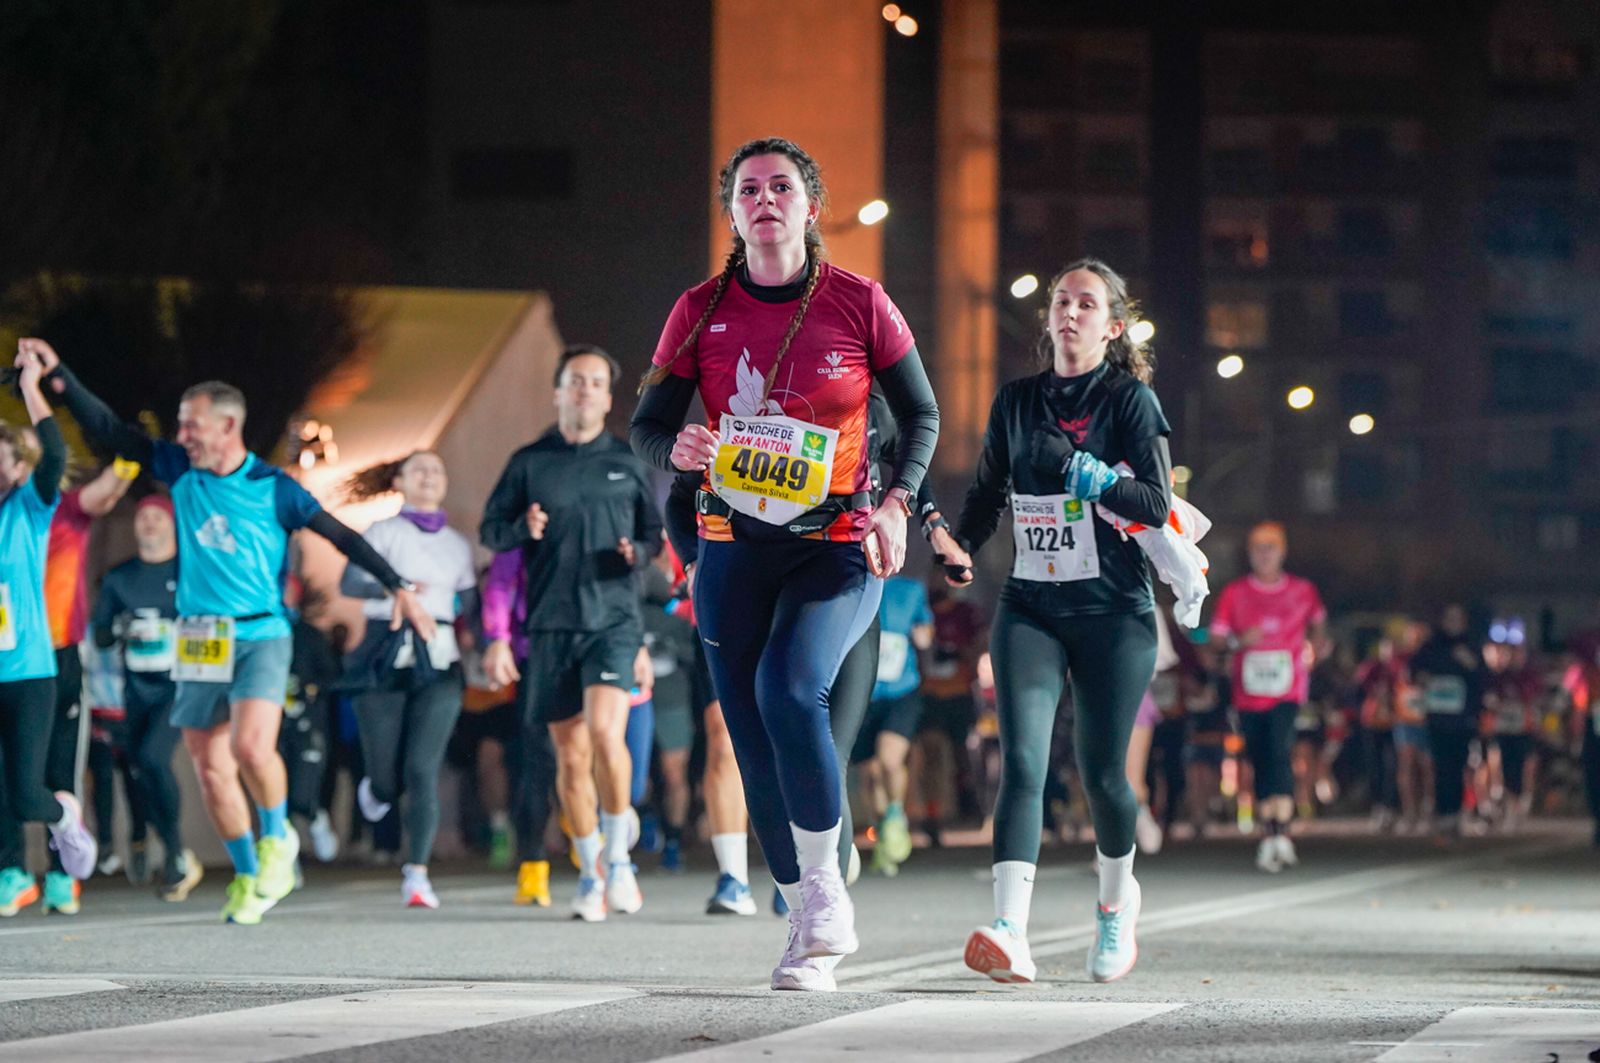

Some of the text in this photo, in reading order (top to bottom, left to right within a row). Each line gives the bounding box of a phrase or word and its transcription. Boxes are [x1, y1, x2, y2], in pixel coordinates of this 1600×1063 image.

[731, 434, 753, 446] SAN
[747, 424, 779, 438] NOCHE
[780, 429, 794, 440] DE
[731, 448, 809, 491] 4049
[741, 482, 789, 499] Carmen Silvia
[1024, 525, 1076, 552] 1224
